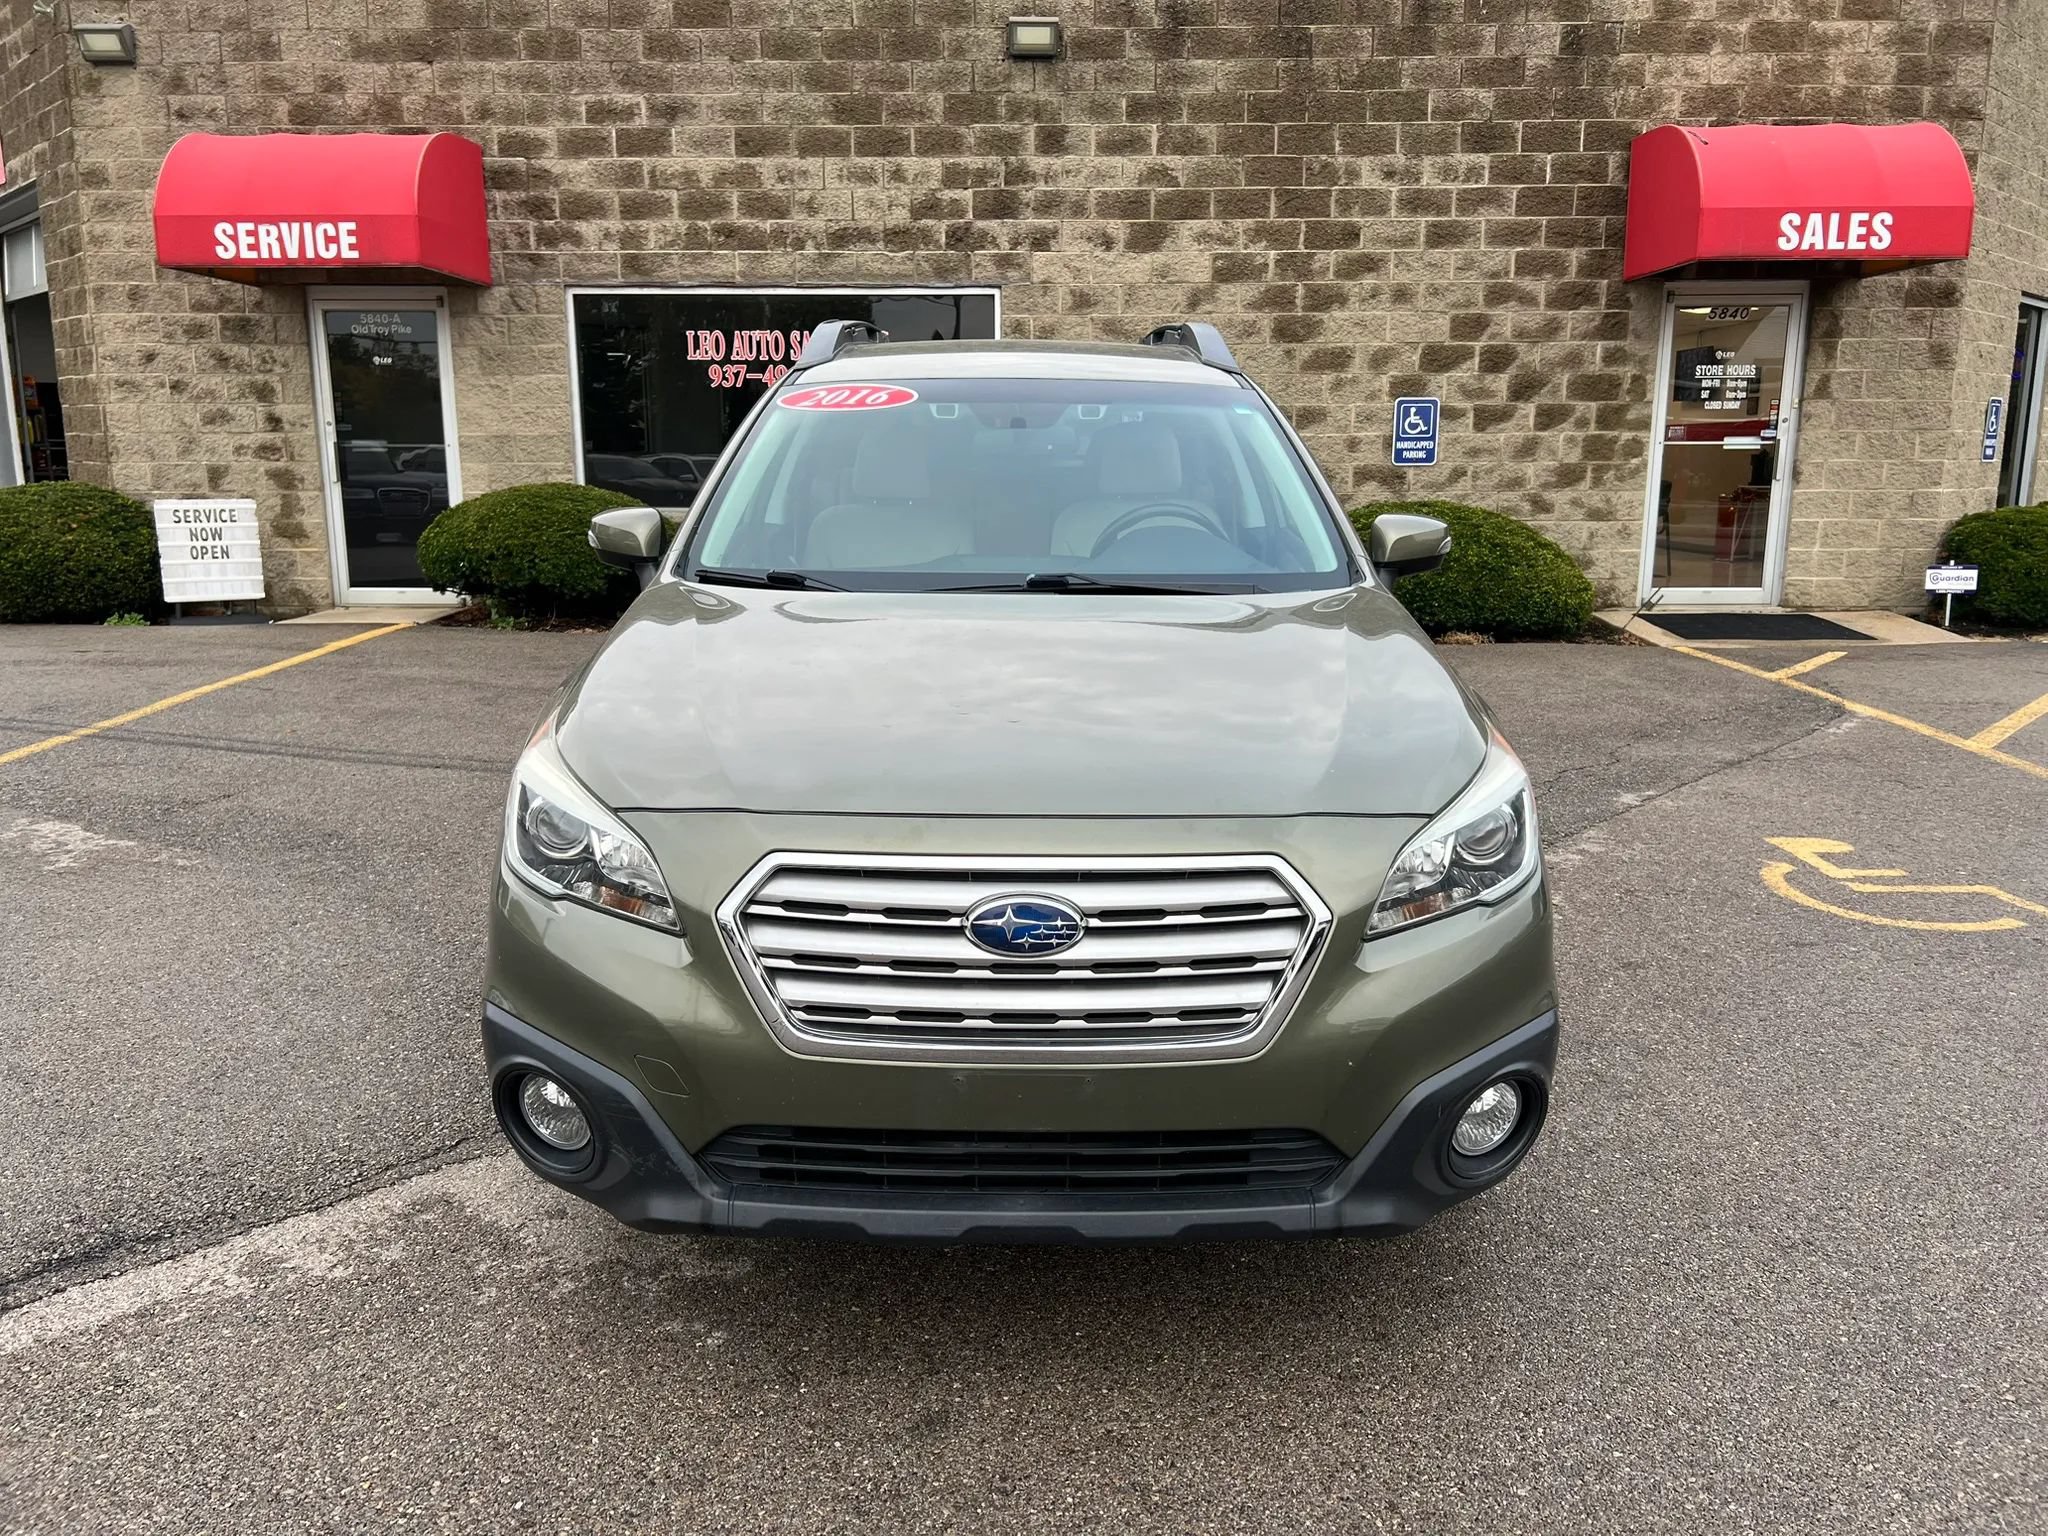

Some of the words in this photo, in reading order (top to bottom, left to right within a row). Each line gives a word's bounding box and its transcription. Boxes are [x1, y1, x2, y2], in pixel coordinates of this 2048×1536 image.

[1777, 211, 1894, 251] SALES
[213, 221, 360, 260] SERVICE
[360, 313, 401, 324] 5840-A
[1708, 307, 1750, 320] 5840
[351, 324, 369, 334] Old
[369, 324, 390, 336] Troy
[391, 324, 412, 334] Pike
[685, 330, 726, 361] LEO
[730, 330, 786, 361] AUTO
[1695, 365, 1724, 376] STORE
[1726, 365, 1756, 376] HOURS
[796, 389, 896, 406] 2016
[1701, 389, 1710, 399] SAT
[1704, 400, 1722, 409] CLOSED
[1722, 400, 1741, 409] SUNDAY
[1396, 441, 1434, 449] HANDICAPPED
[1402, 450, 1427, 459] PARKING
[172, 508, 237, 524] SERVICE
[189, 527, 223, 541] NOW
[190, 545, 230, 560] OPEN
[1931, 573, 1974, 583] Guardian
